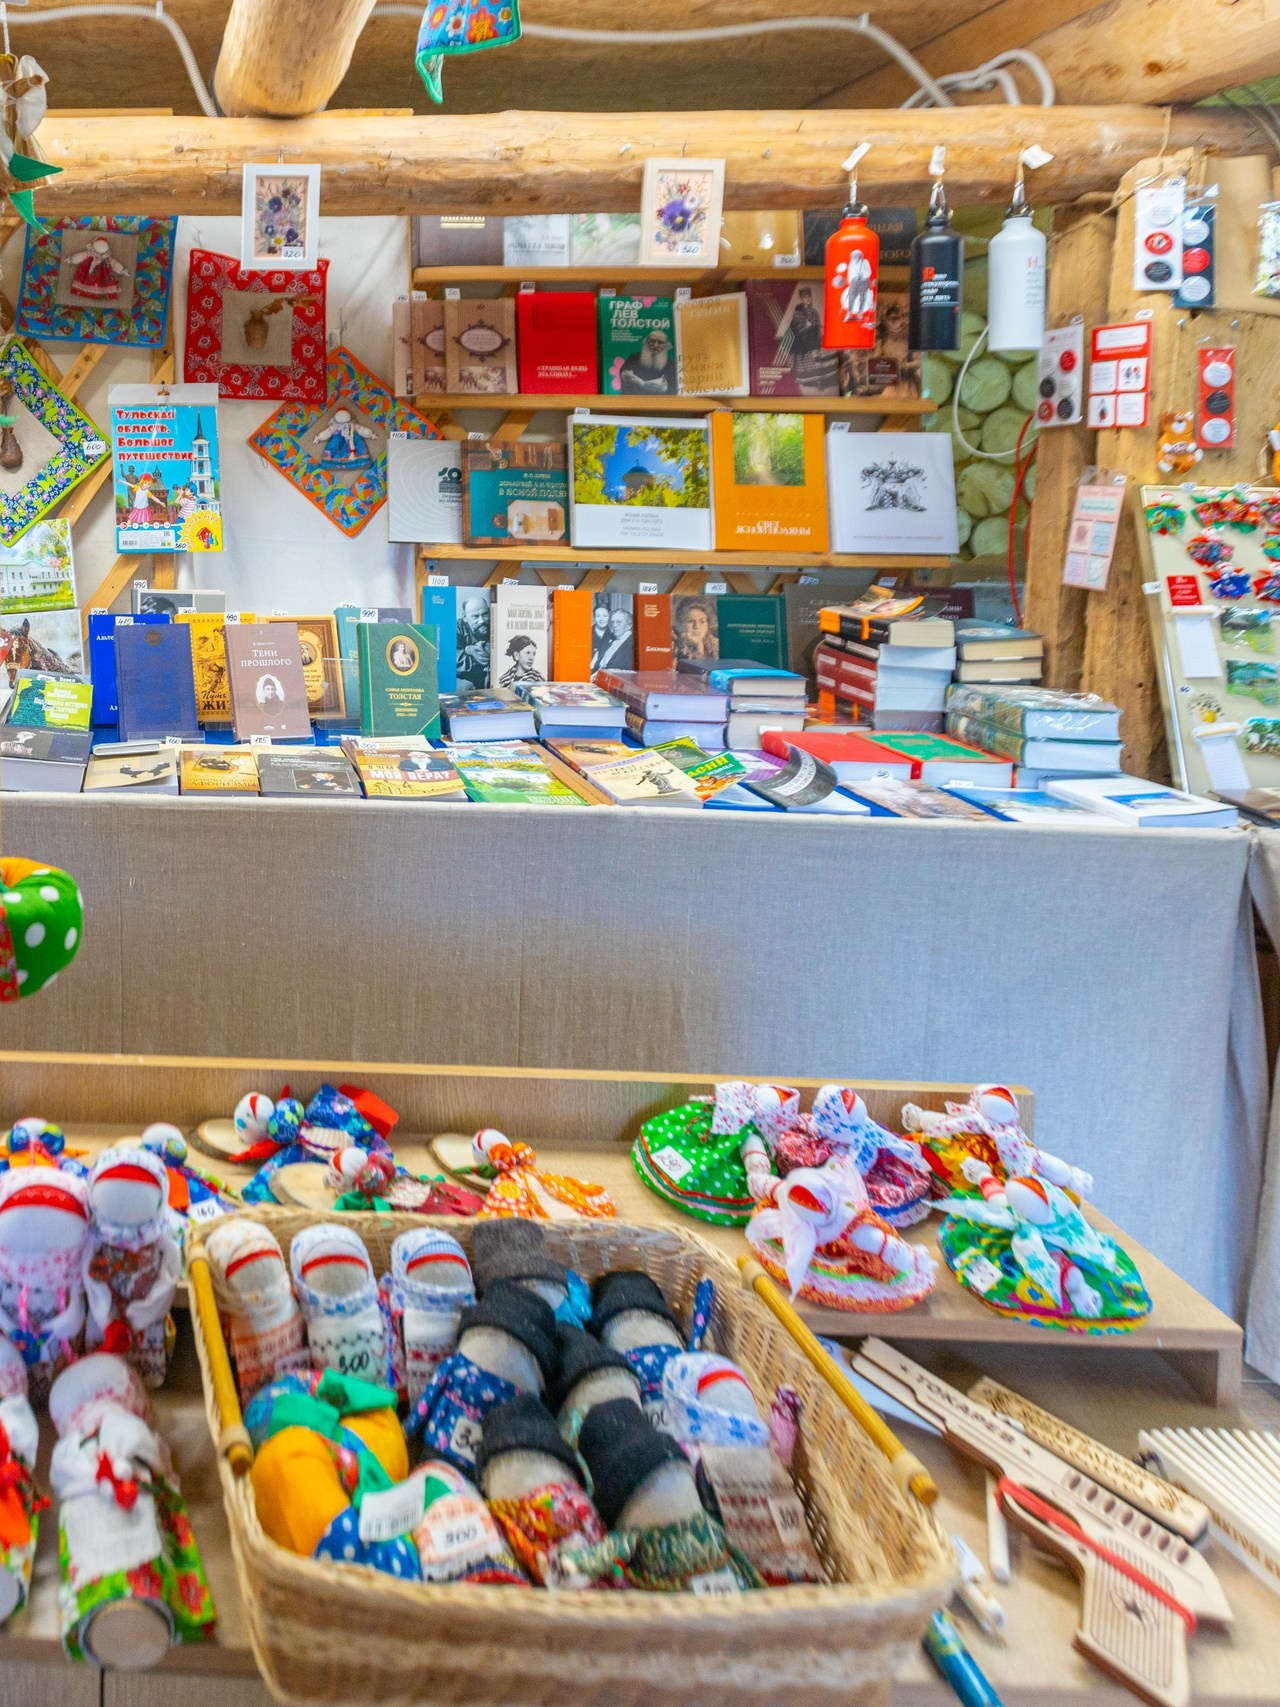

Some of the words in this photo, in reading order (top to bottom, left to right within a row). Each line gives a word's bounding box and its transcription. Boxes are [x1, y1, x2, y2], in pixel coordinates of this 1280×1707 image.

[609, 301, 643, 310] ГРАФ
[613, 310, 638, 318] ЛЕВ
[610, 318, 670, 328] ТОЛСТОЙ
[240, 658, 292, 667] ПРОШЛОГО
[202, 690, 226, 700] Путь
[370, 770, 403, 779] МОЯ
[408, 770, 450, 780] ВЕРА?
